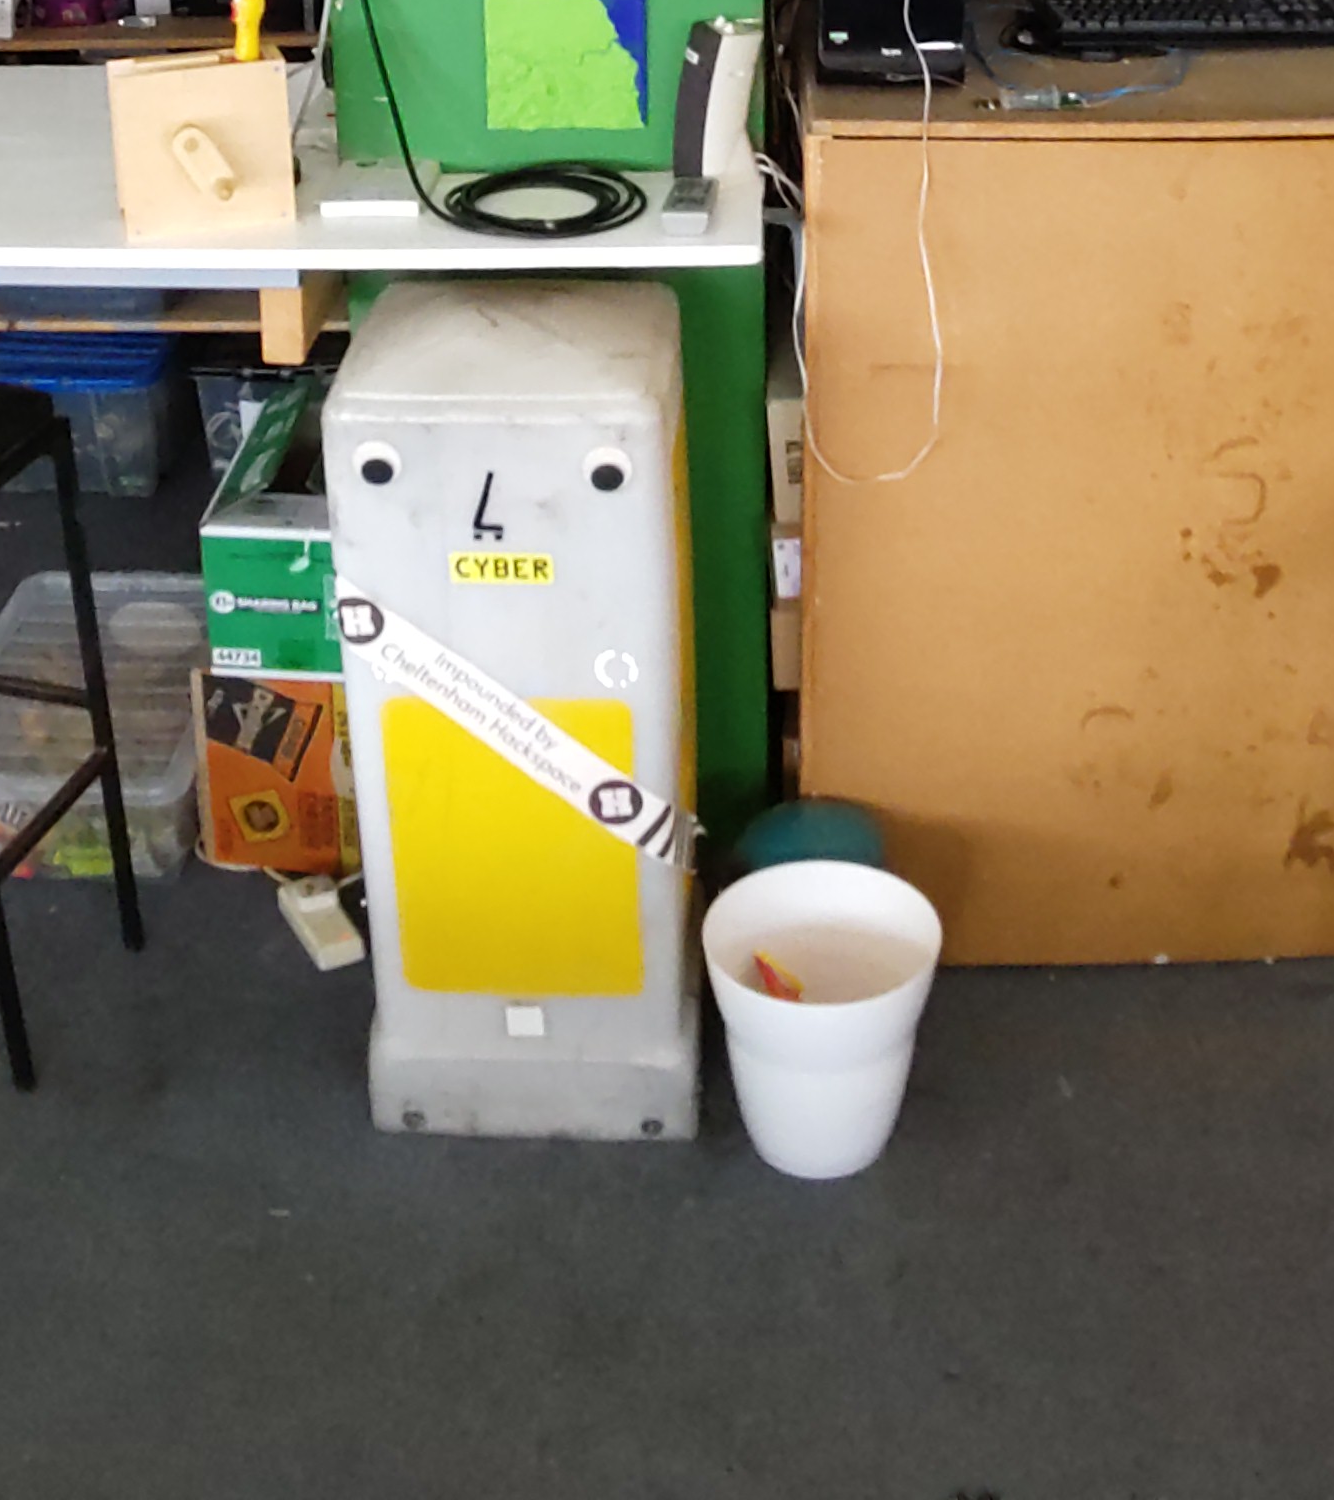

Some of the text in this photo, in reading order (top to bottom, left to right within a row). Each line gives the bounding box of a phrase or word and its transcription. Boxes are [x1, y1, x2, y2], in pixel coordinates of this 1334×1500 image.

[454, 556, 549, 580] CYBER
[380, 642, 584, 795] Cheltenham Hackspace
[434, 651, 558, 752] Impounded by
